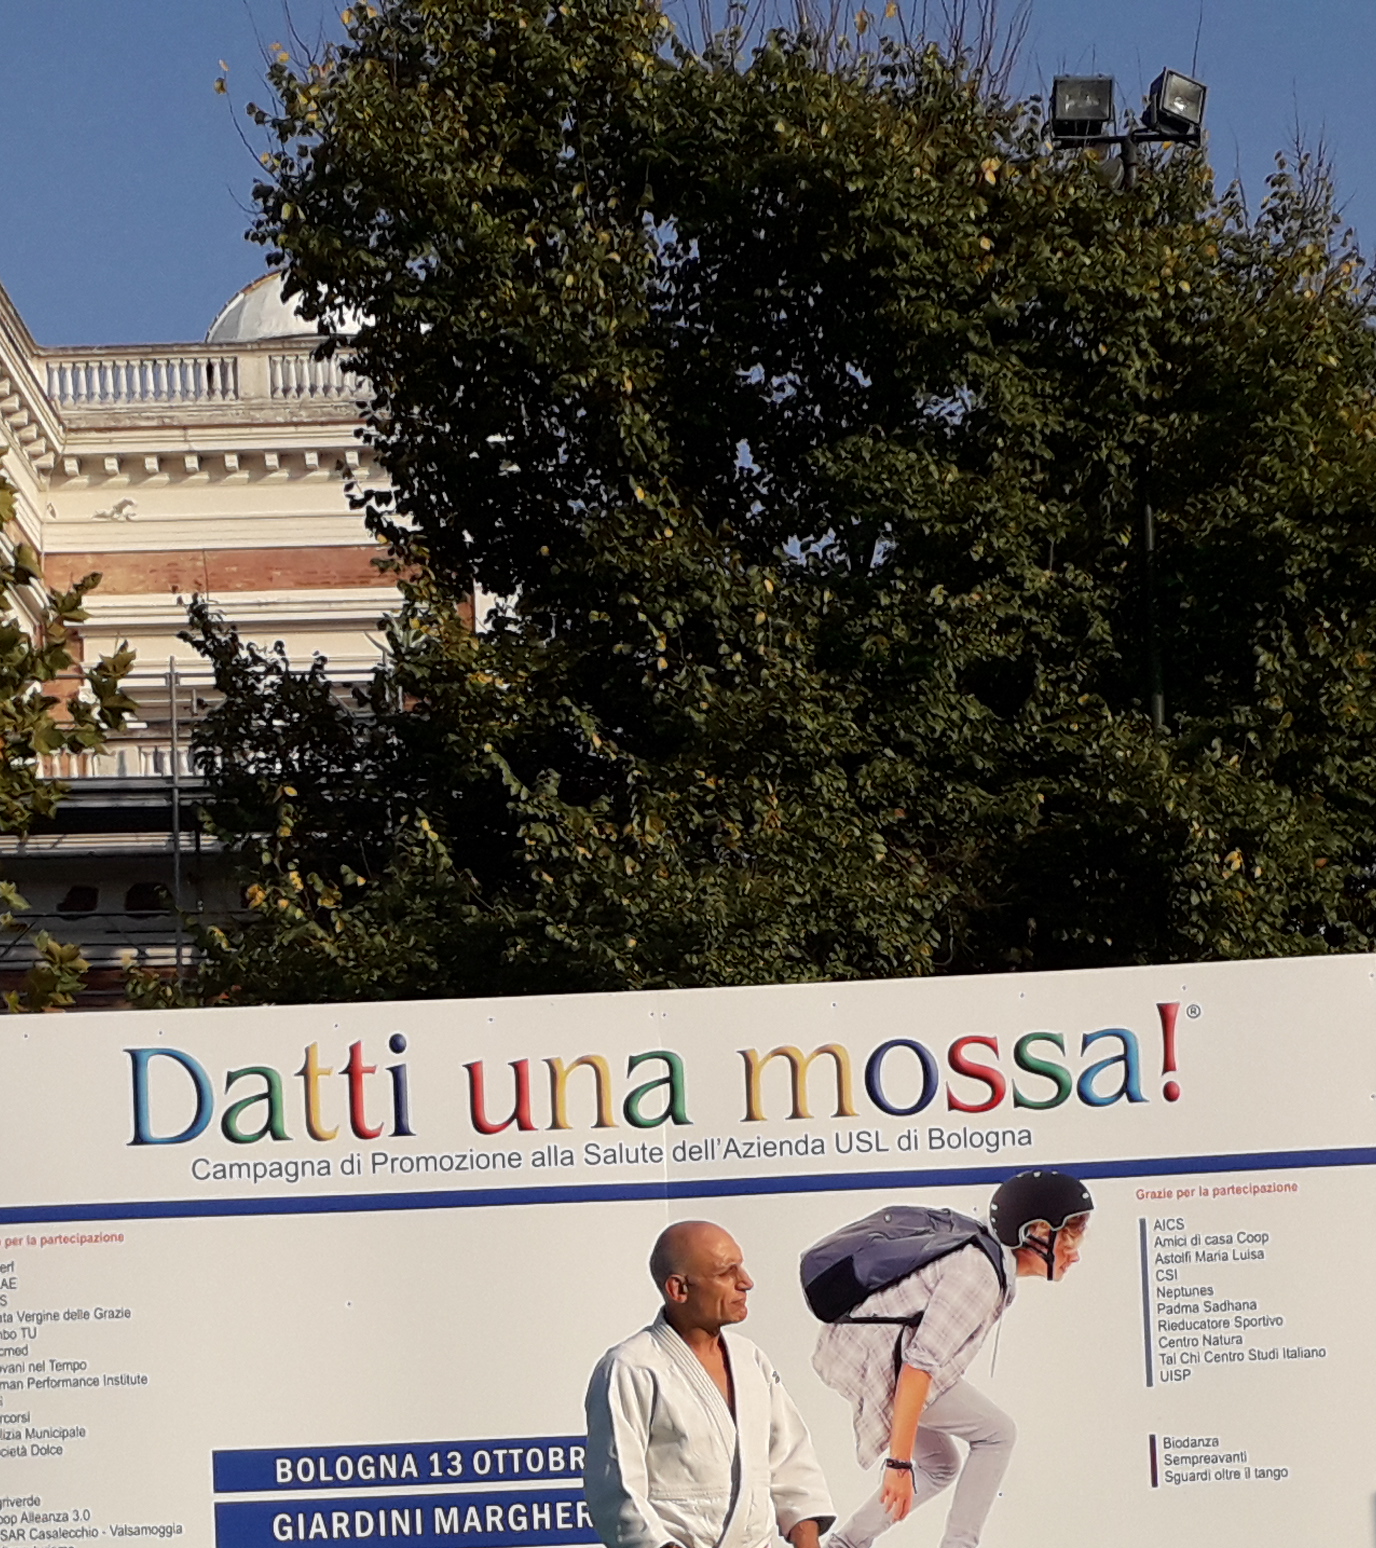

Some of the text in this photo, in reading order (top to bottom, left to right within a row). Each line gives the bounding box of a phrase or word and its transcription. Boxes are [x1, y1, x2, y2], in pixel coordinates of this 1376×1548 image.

[122, 1001, 1181, 1147] Datti una mossa!
[191, 1125, 1033, 1183] Campagna di Promozione alla Salute dell'Azienda USL di Bologna
[1136, 1182, 1298, 1200] Grazie per la partecipazione
[1154, 1218, 1185, 1230] AICS
[5, 1236, 24, 1249] per
[27, 1235, 37, 1246] la
[40, 1232, 124, 1247] partecipazione
[1154, 1231, 1269, 1248] Amici di casa Coop
[1155, 1248, 1265, 1264] Astolfi Maria Luisa
[1155, 1269, 1178, 1282] CSI
[1156, 1285, 1214, 1299] Neptunes
[17, 1309, 60, 1325] Vergine
[63, 1308, 90, 1320] delle
[94, 1306, 131, 1320] Grazie
[1157, 1300, 1257, 1315] Padma Sadhana
[1158, 1315, 1283, 1332] Rieducatore Sportivo
[21, 1326, 37, 1340] TU
[1159, 1333, 1243, 1349] Centro Natura
[1159, 1346, 1326, 1366] Tai Chi Centro Studi Italiano
[29, 1360, 45, 1373] nel
[49, 1358, 87, 1373] Tempo
[28, 1374, 99, 1389] Performance
[103, 1373, 148, 1387] Institute
[1160, 1369, 1191, 1382] UISP
[25, 1426, 86, 1442] Municipale
[31, 1443, 63, 1456] Dolce
[1163, 1436, 1219, 1449] Biodanza
[275, 1446, 585, 1484] BOLOGNA 13 OTTOBR
[1164, 1451, 1248, 1467] Sempreavanti
[1164, 1466, 1289, 1485] Sguardi oltre il tango
[21, 1511, 69, 1524] Alleanza
[72, 1509, 91, 1522] 3.0
[273, 1502, 593, 1542] GIARDINI MARGHER
[29, 1526, 98, 1540] Casalecchio
[109, 1523, 183, 1539] Valsamoggia
